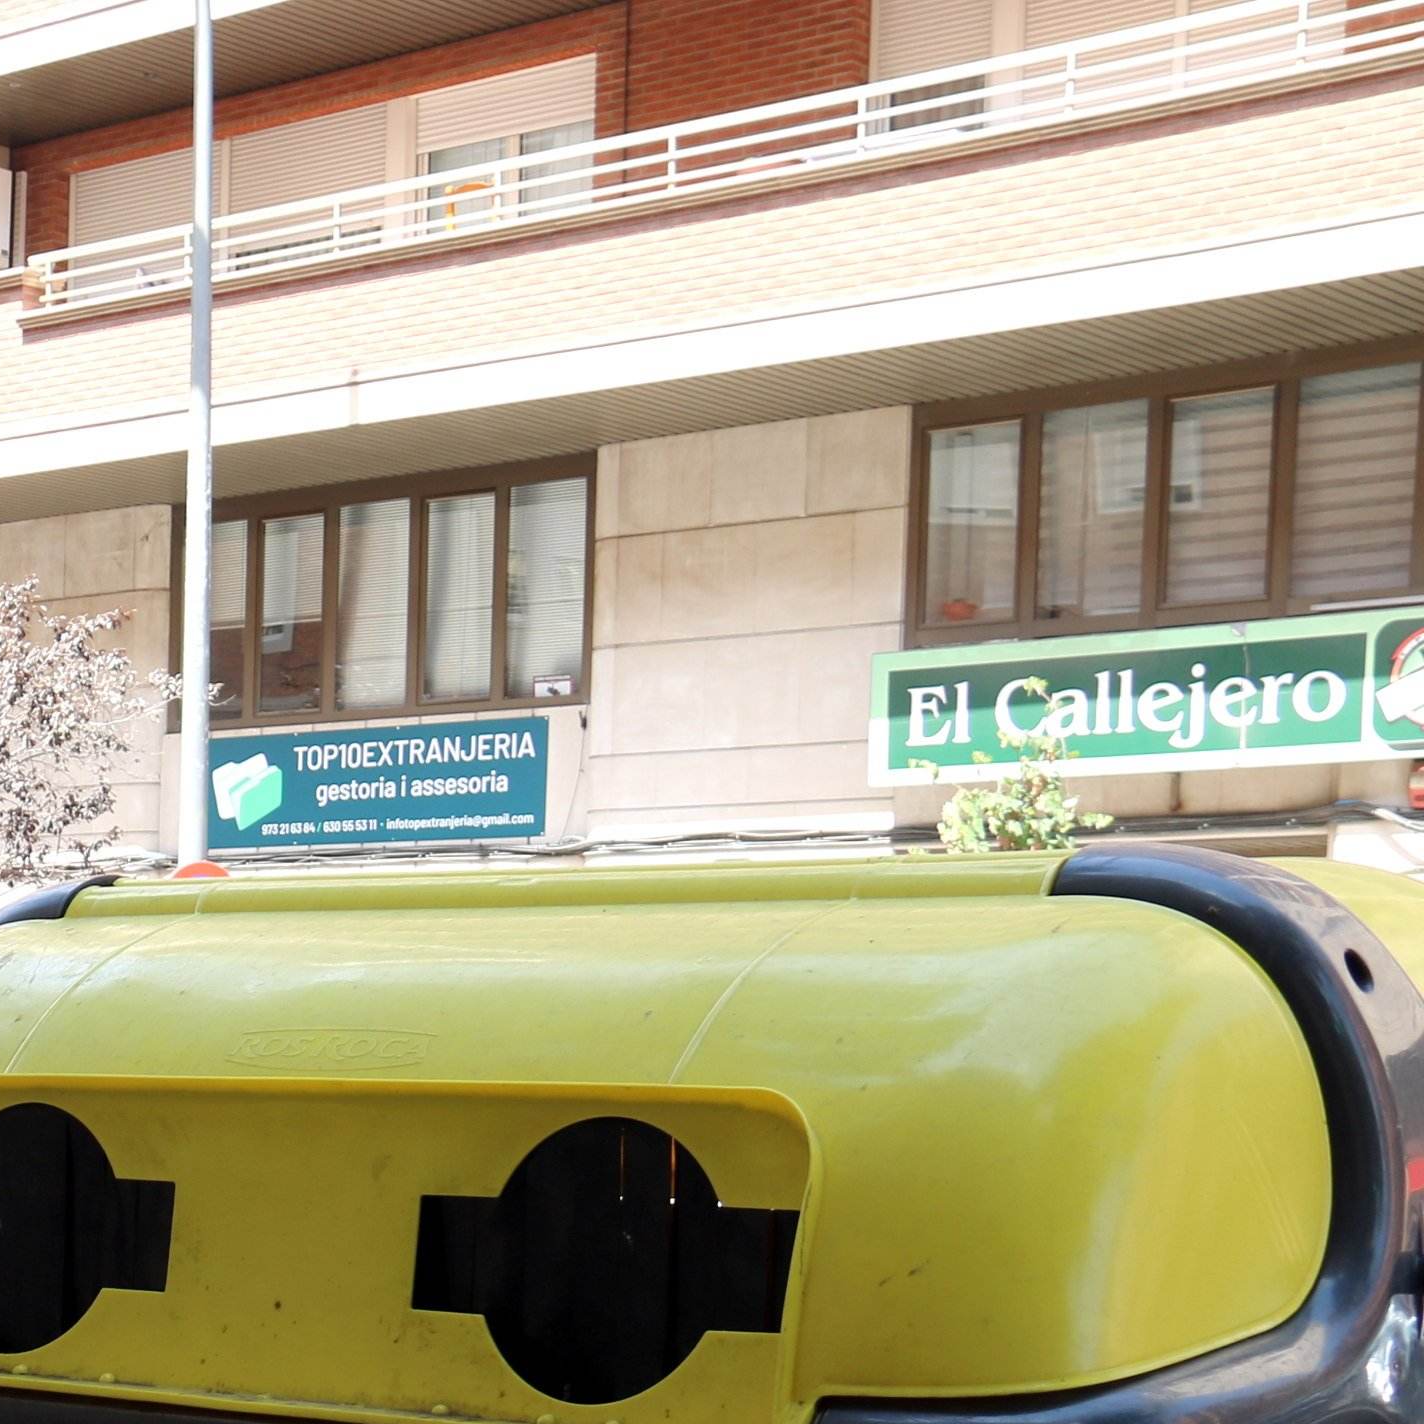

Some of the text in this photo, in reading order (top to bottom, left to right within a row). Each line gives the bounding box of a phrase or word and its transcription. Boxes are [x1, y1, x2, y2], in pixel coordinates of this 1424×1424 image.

[905, 662, 1348, 749] El Callejero
[293, 731, 536, 772] TOP10EXTRANJERIA
[316, 769, 509, 808] gestoria i assesoria
[261, 823, 279, 836] 973
[279, 822, 289, 835] 21
[342, 819, 354, 832] 55
[385, 812, 535, 832] infotopextranjeria@gmail.com
